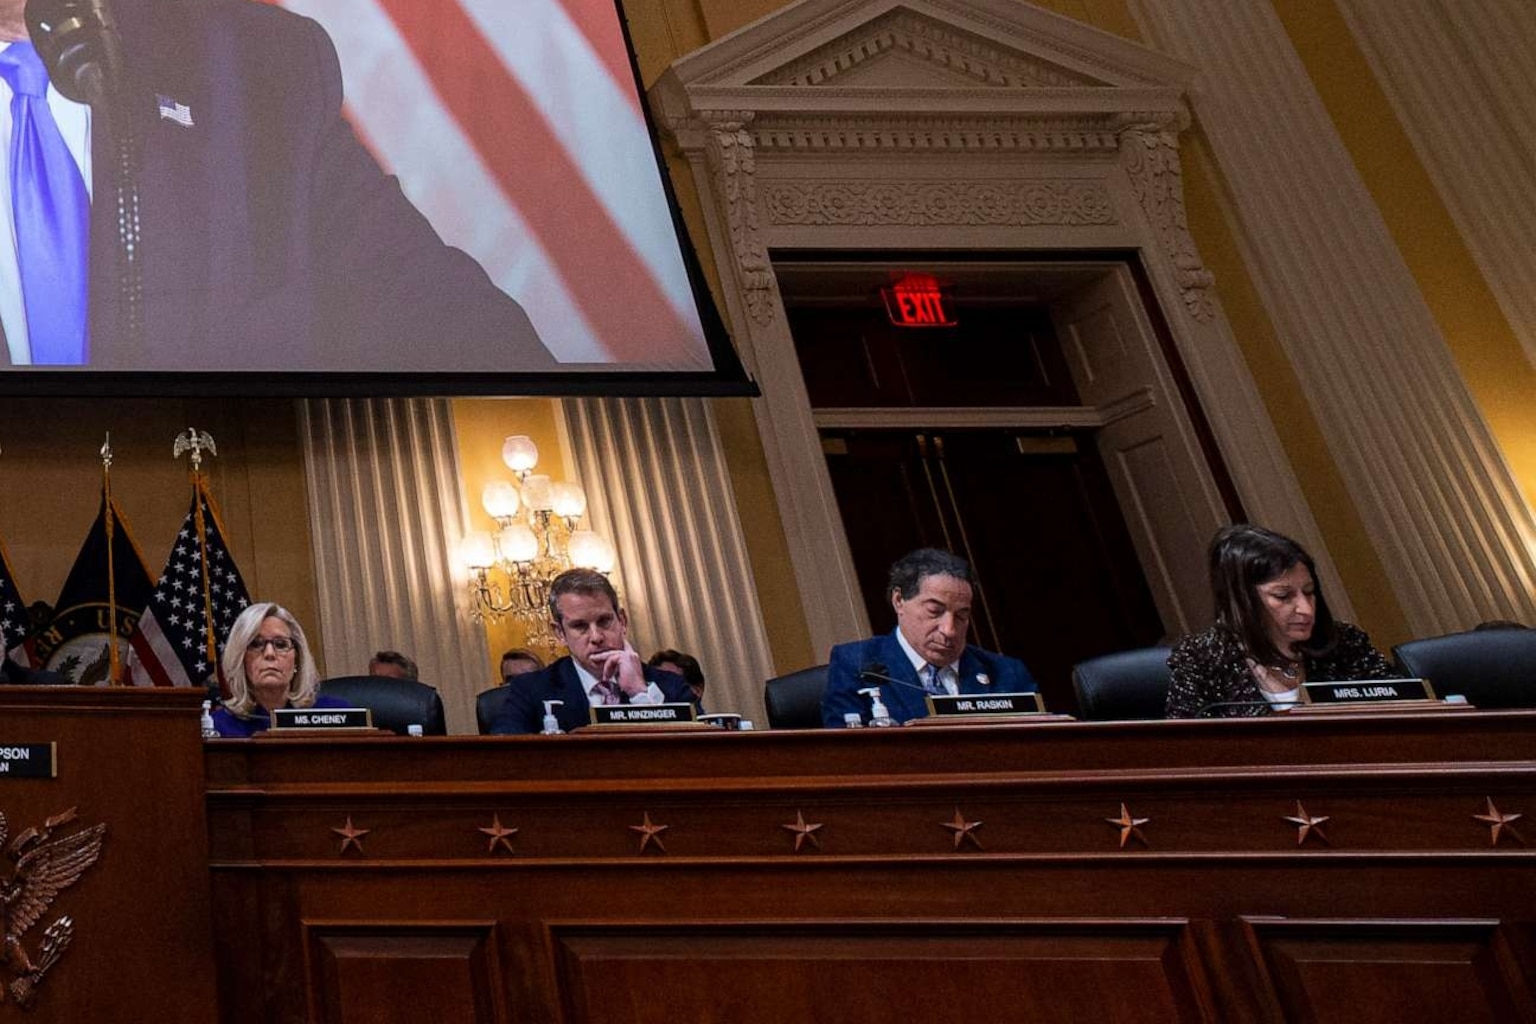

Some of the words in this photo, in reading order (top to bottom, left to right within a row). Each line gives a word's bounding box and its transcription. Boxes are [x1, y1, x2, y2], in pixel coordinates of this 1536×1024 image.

[894, 291, 947, 324] EXIT
[1333, 687, 1363, 698] MRS.
[1363, 686, 1398, 698] LURIA
[956, 700, 976, 711] MR.
[976, 699, 1014, 710] RASKIN
[294, 715, 311, 725] MS.
[311, 714, 347, 725] CHENEY
[609, 710, 628, 720] MR.
[628, 709, 677, 720] KINZINGER
